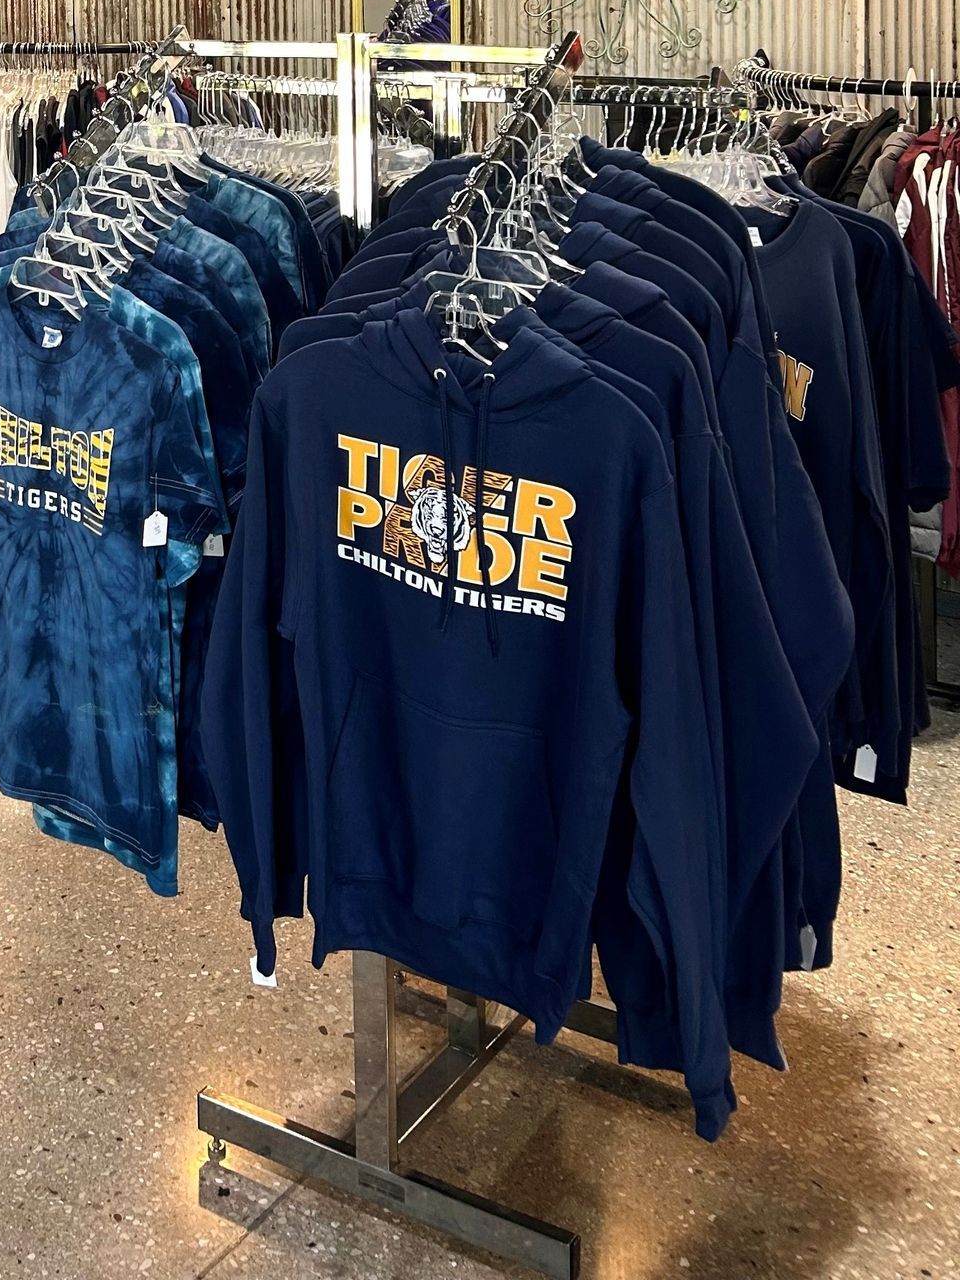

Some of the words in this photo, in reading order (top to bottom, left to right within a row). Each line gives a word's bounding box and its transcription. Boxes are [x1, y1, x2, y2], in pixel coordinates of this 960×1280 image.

[6, 482, 82, 522] TIGERS
[338, 433, 576, 545] TIGER
[338, 543, 442, 598] CHILTON
[453, 586, 565, 622] TIGERS
